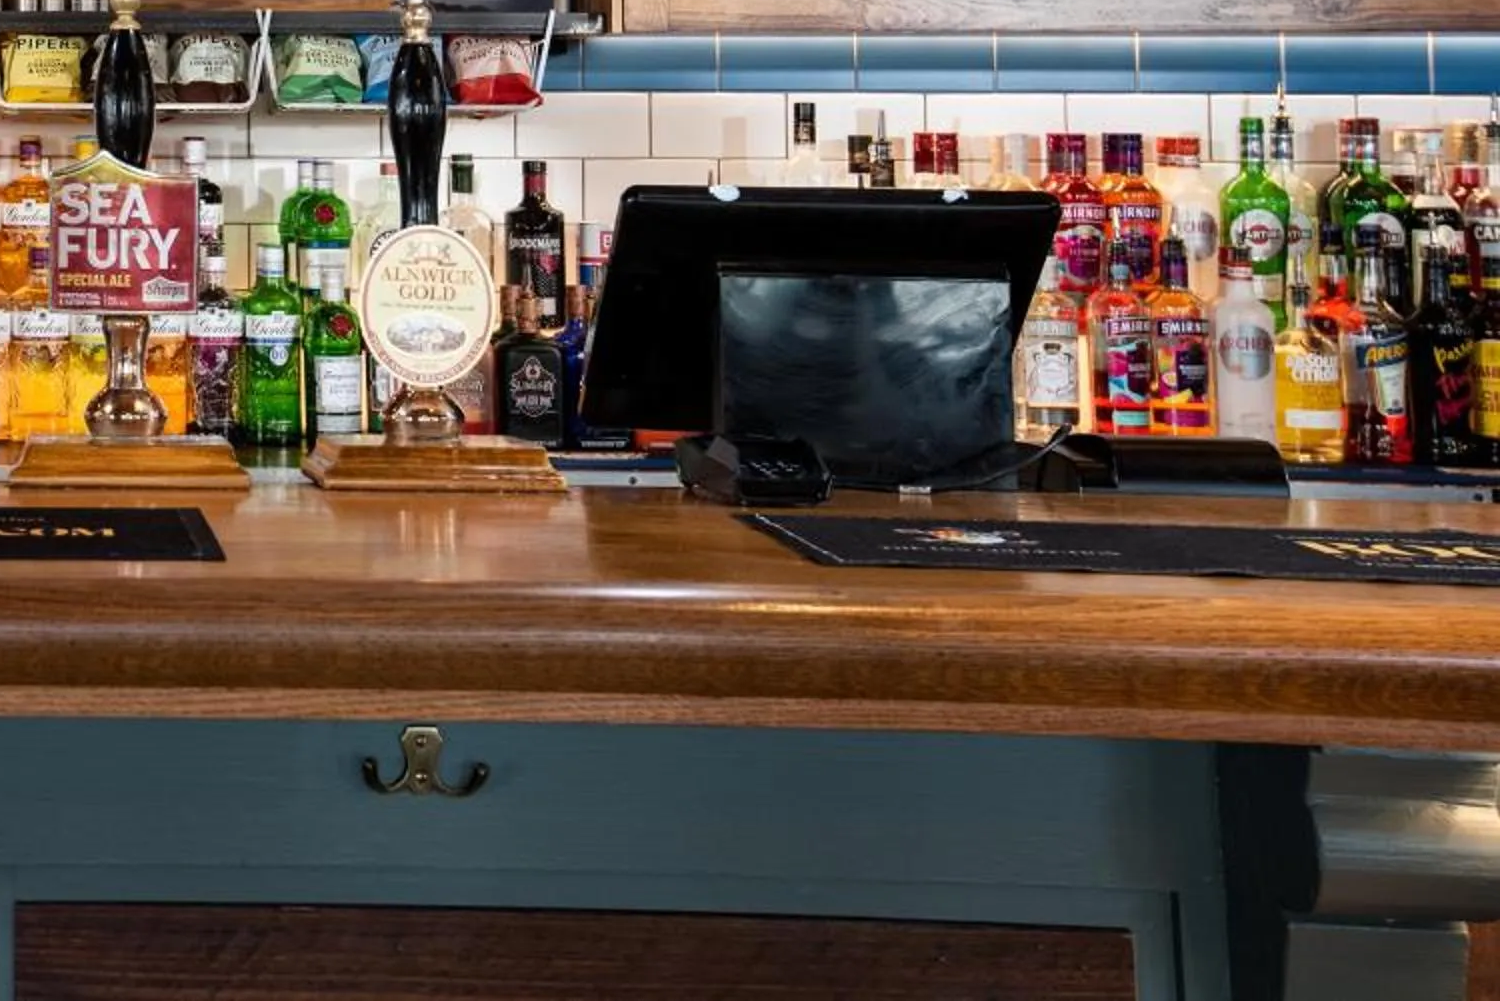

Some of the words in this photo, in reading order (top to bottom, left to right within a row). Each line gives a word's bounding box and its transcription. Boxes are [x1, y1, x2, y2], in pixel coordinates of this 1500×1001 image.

[58, 182, 153, 226] SEA
[58, 273, 107, 288] SPECIAL
[109, 273, 133, 288] ALE
[380, 266, 475, 285] ALNWICK
[398, 284, 457, 301] GOLD
